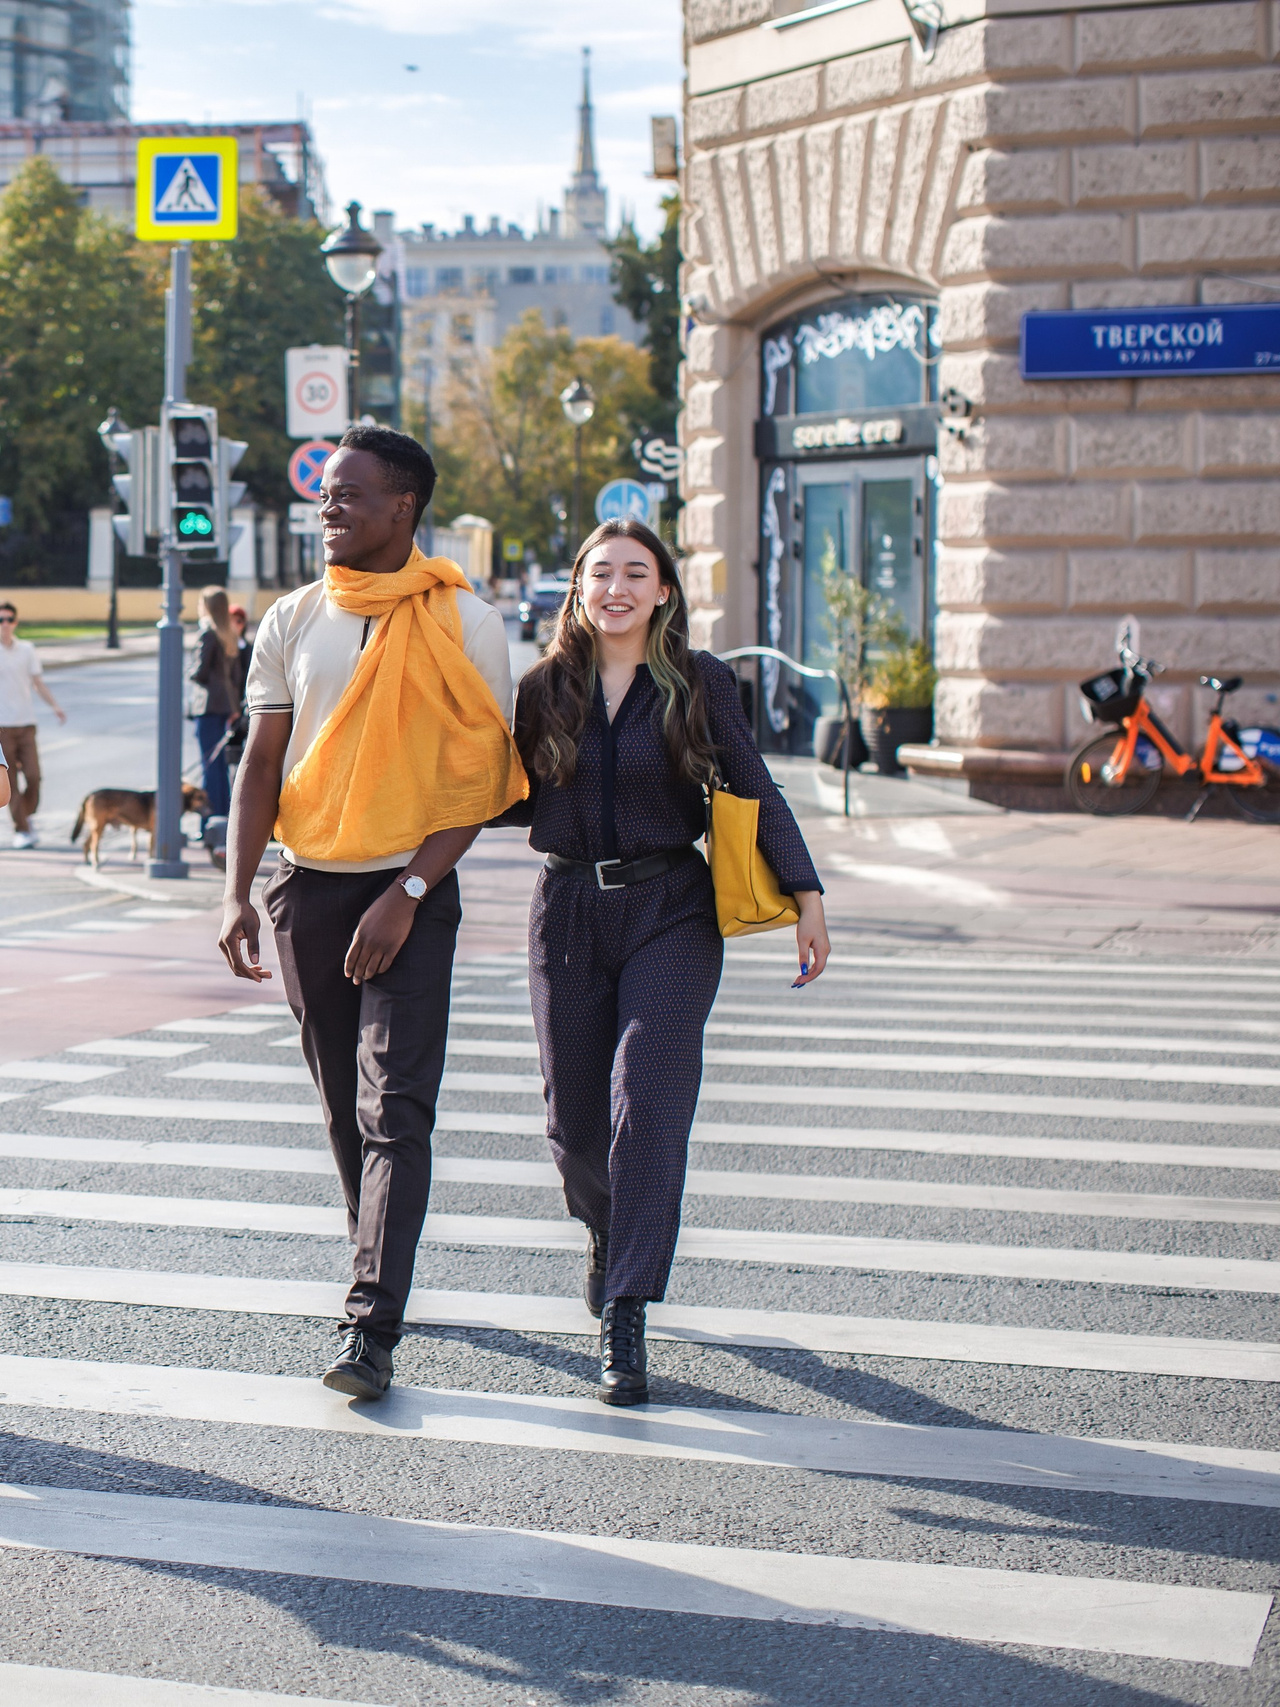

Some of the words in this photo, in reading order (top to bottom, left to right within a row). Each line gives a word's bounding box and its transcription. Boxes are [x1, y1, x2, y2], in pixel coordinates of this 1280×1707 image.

[1091, 318, 1223, 348] ТВЕРСКОЙ
[1119, 349, 1196, 365] БУЛЬВАР
[305, 384, 329, 402] 30
[861, 418, 902, 444] era
